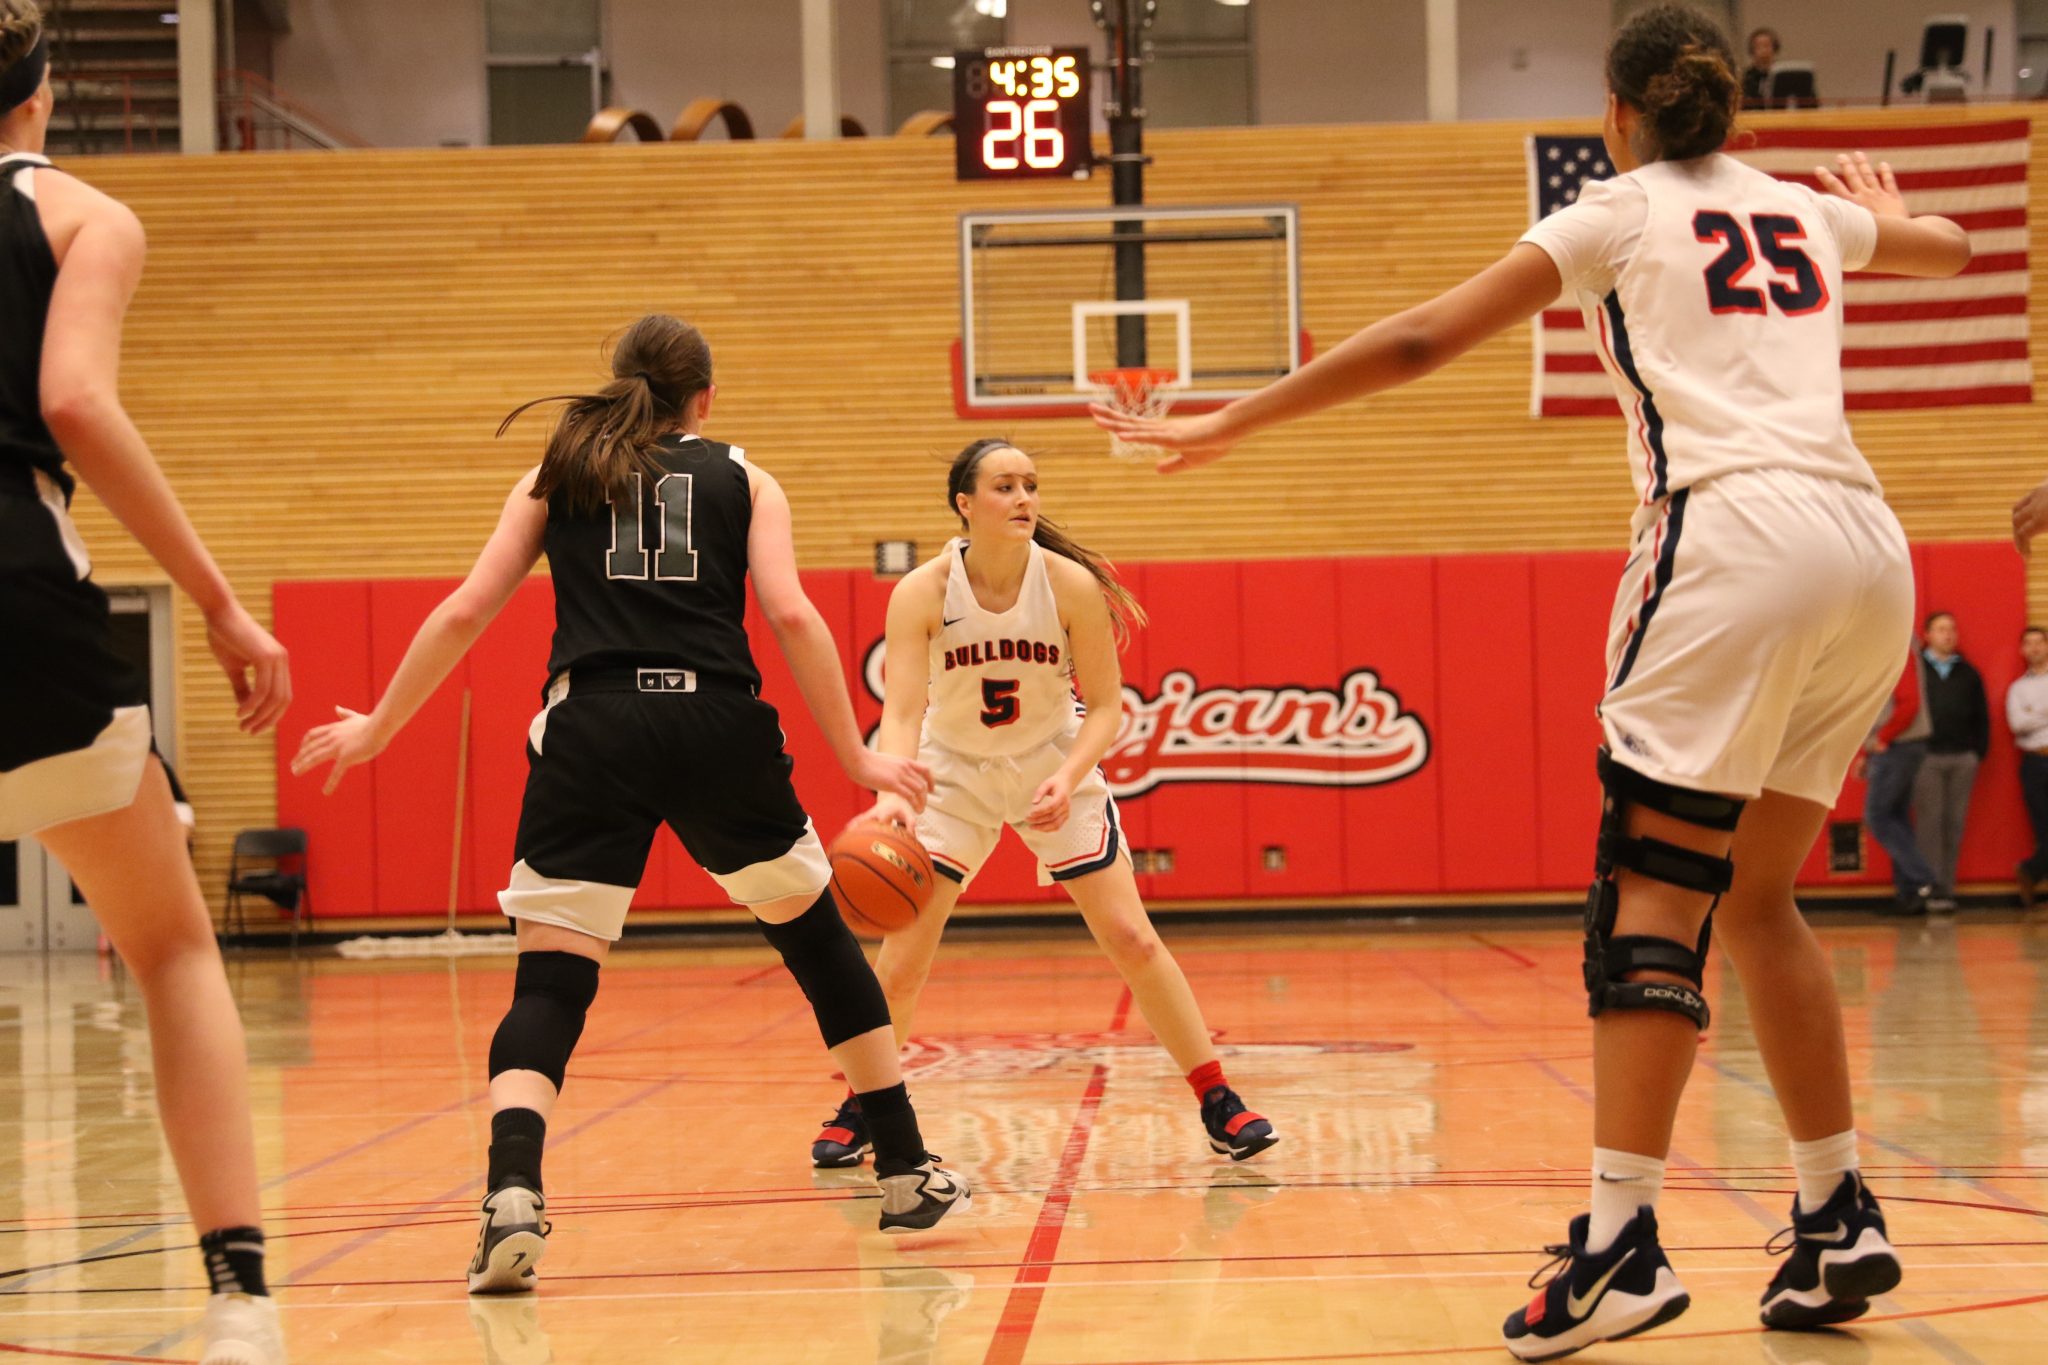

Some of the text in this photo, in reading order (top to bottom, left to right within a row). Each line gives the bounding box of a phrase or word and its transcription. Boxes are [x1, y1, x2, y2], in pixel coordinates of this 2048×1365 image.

[990, 56, 1080, 98] 4:35
[983, 100, 1064, 170] 26
[1691, 209, 1831, 318] 25
[605, 472, 698, 581] 11
[944, 638, 1061, 671] BULLDOGS
[980, 677, 1020, 729] 5
